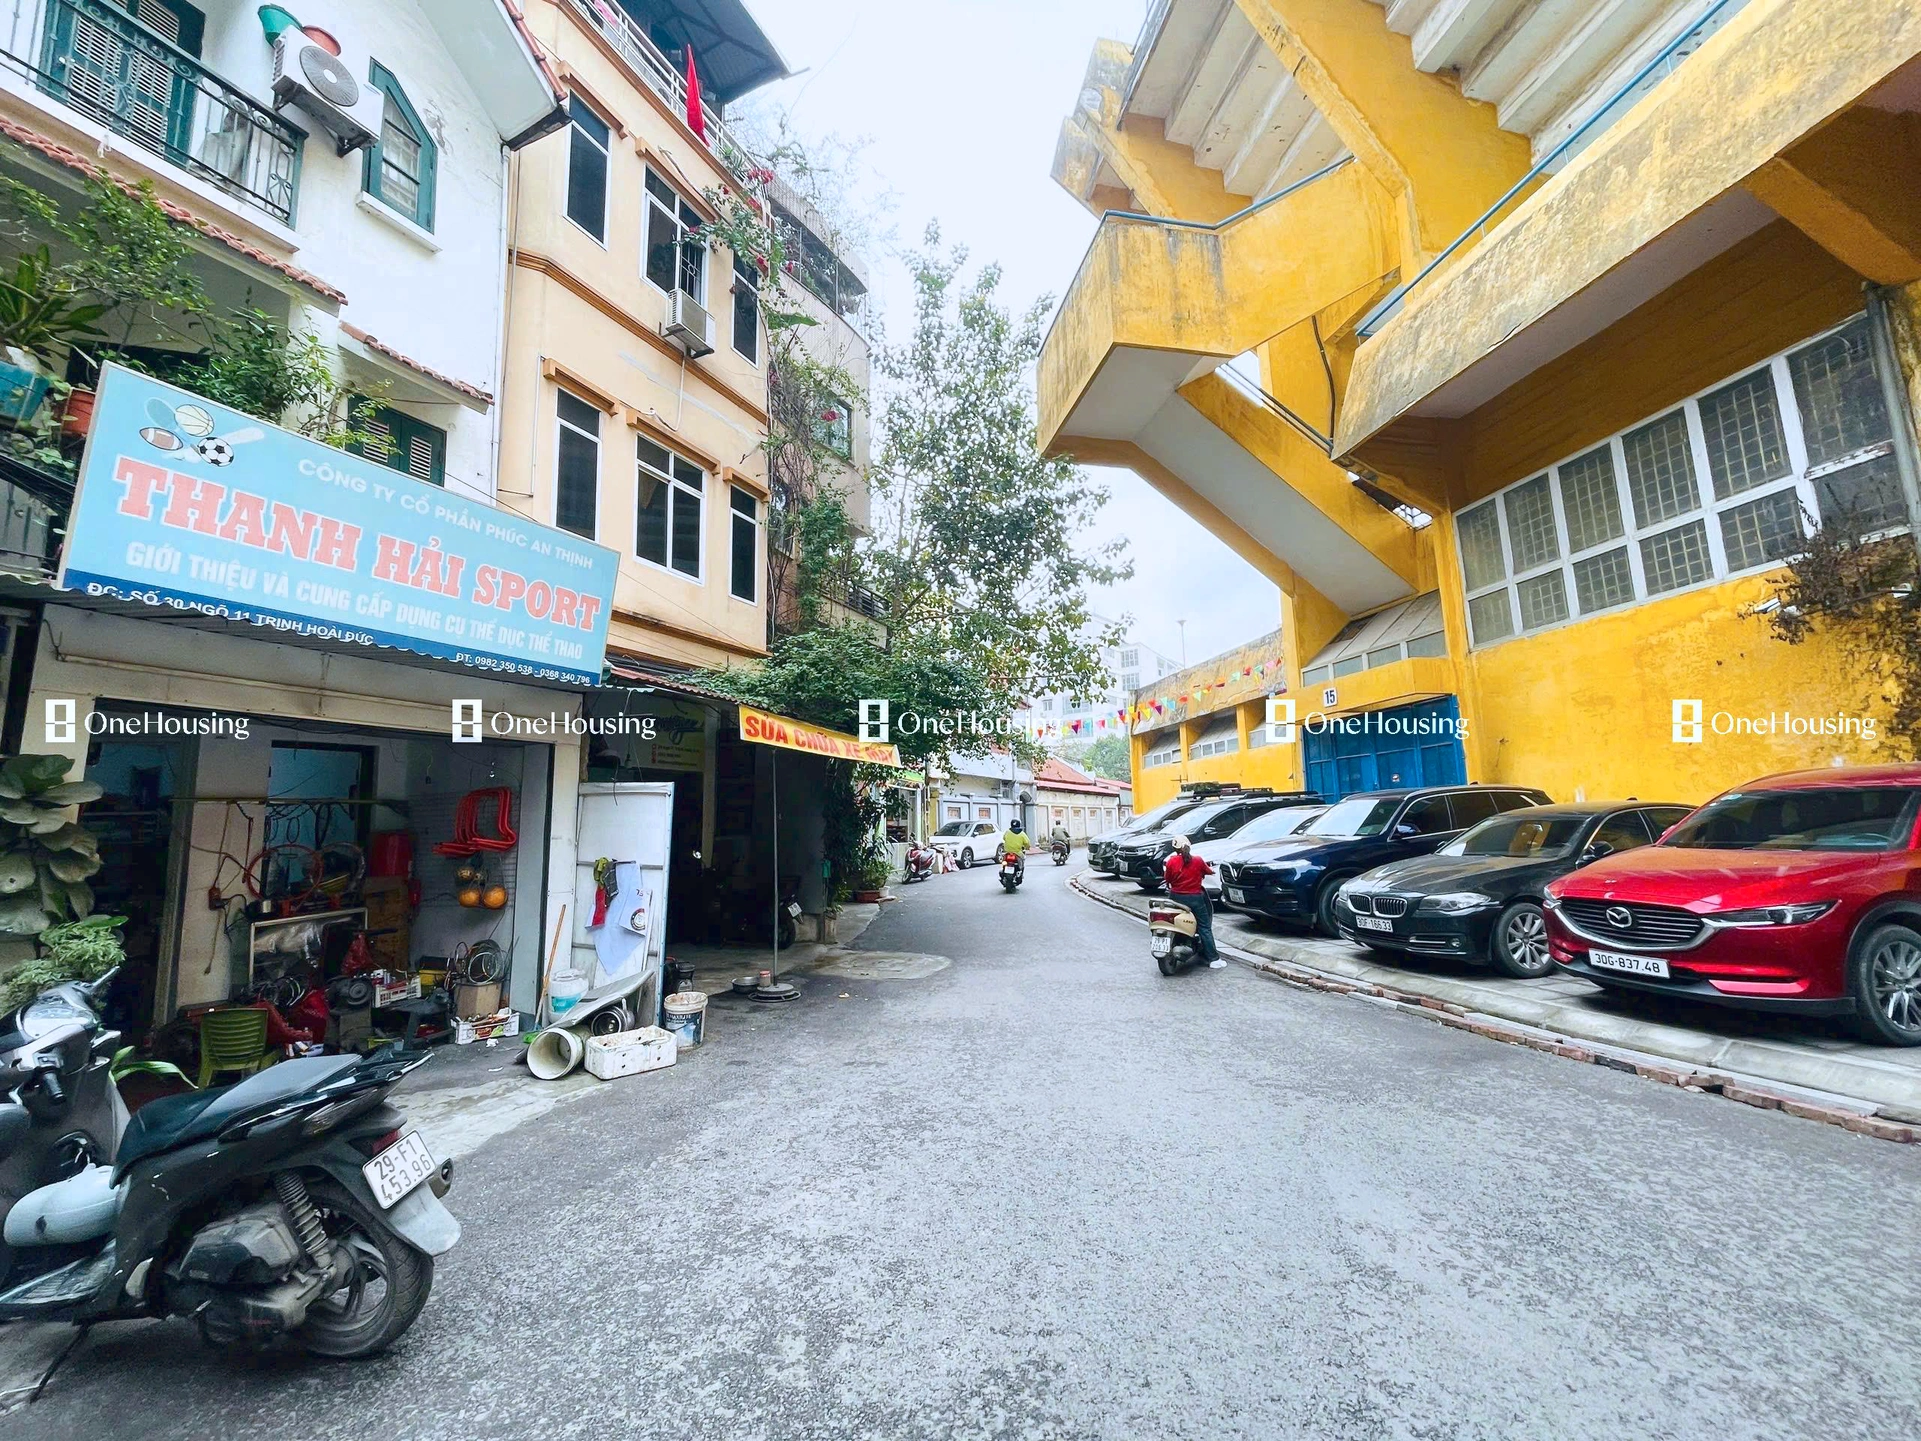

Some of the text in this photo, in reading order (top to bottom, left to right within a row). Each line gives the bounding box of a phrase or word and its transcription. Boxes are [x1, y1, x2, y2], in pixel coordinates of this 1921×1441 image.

[298, 459, 367, 493] CÔNG
[373, 483, 397, 503] TY
[400, 493, 431, 515] CỔ
[486, 522, 528, 547] PHÚC
[530, 540, 552, 555] AN
[555, 546, 593, 569] THỊNH
[113, 453, 601, 632] THANH HẢI SPORT
[125, 541, 181, 575] GIỚI
[188, 554, 257, 591] THIỆU
[263, 571, 289, 598] VÀ
[296, 580, 352, 611] CUNG
[355, 590, 393, 619] CẤP
[396, 602, 442, 630] DỤNG
[444, 614, 466, 640] CỤ
[497, 626, 526, 650] DỤC
[554, 639, 583, 660] THAO
[130, 590, 161, 605] SỐ
[234, 610, 250, 620] 11
[306, 625, 342, 639] HOÀI
[345, 631, 375, 645] ĐỨC
[456, 652, 472, 663] ĐT:
[475, 655, 497, 668] 0982
[500, 660, 516, 671] 350
[517, 663, 533, 674] 538
[540, 667, 559, 679] 0368
[561, 672, 575, 682] 340
[576, 675, 590, 684] 796
[1325, 689, 1336, 704] 15
[745, 713, 789, 745] SỬA
[793, 728, 840, 755] CHỮA
[843, 740, 865, 759] XE
[1595, 953, 1660, 973] 30G-837.48
[374, 1138, 418, 1181] 29-F1
[381, 1153, 432, 1201] 453.96
